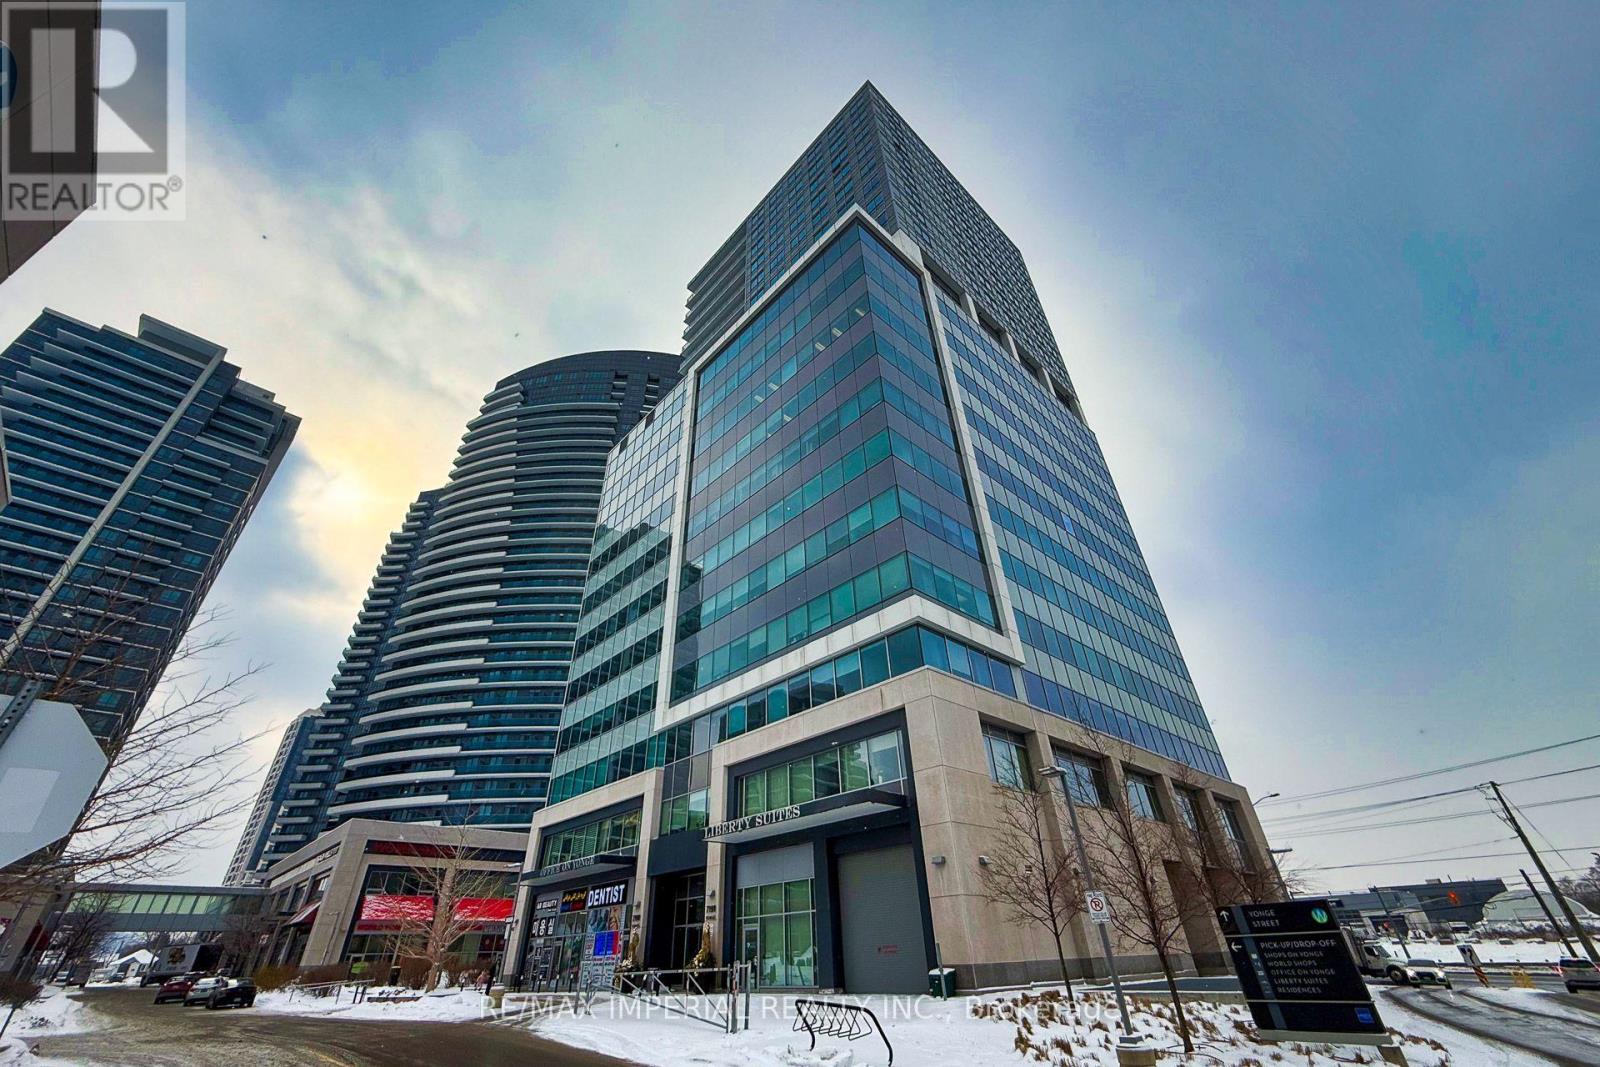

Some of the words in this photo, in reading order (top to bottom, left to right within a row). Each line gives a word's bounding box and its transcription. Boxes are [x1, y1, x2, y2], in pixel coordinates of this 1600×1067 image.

[704, 817, 752, 839] LIBERTY
[755, 805, 800, 827] SUITES
[588, 883, 626, 907] DENTIST
[1248, 909, 1276, 917] YONGE
[1252, 919, 1280, 928] STREET
[1260, 939, 1337, 949] PICK-UP/DROP-OFF
[1277, 986, 1322, 994] RESIDENCES
